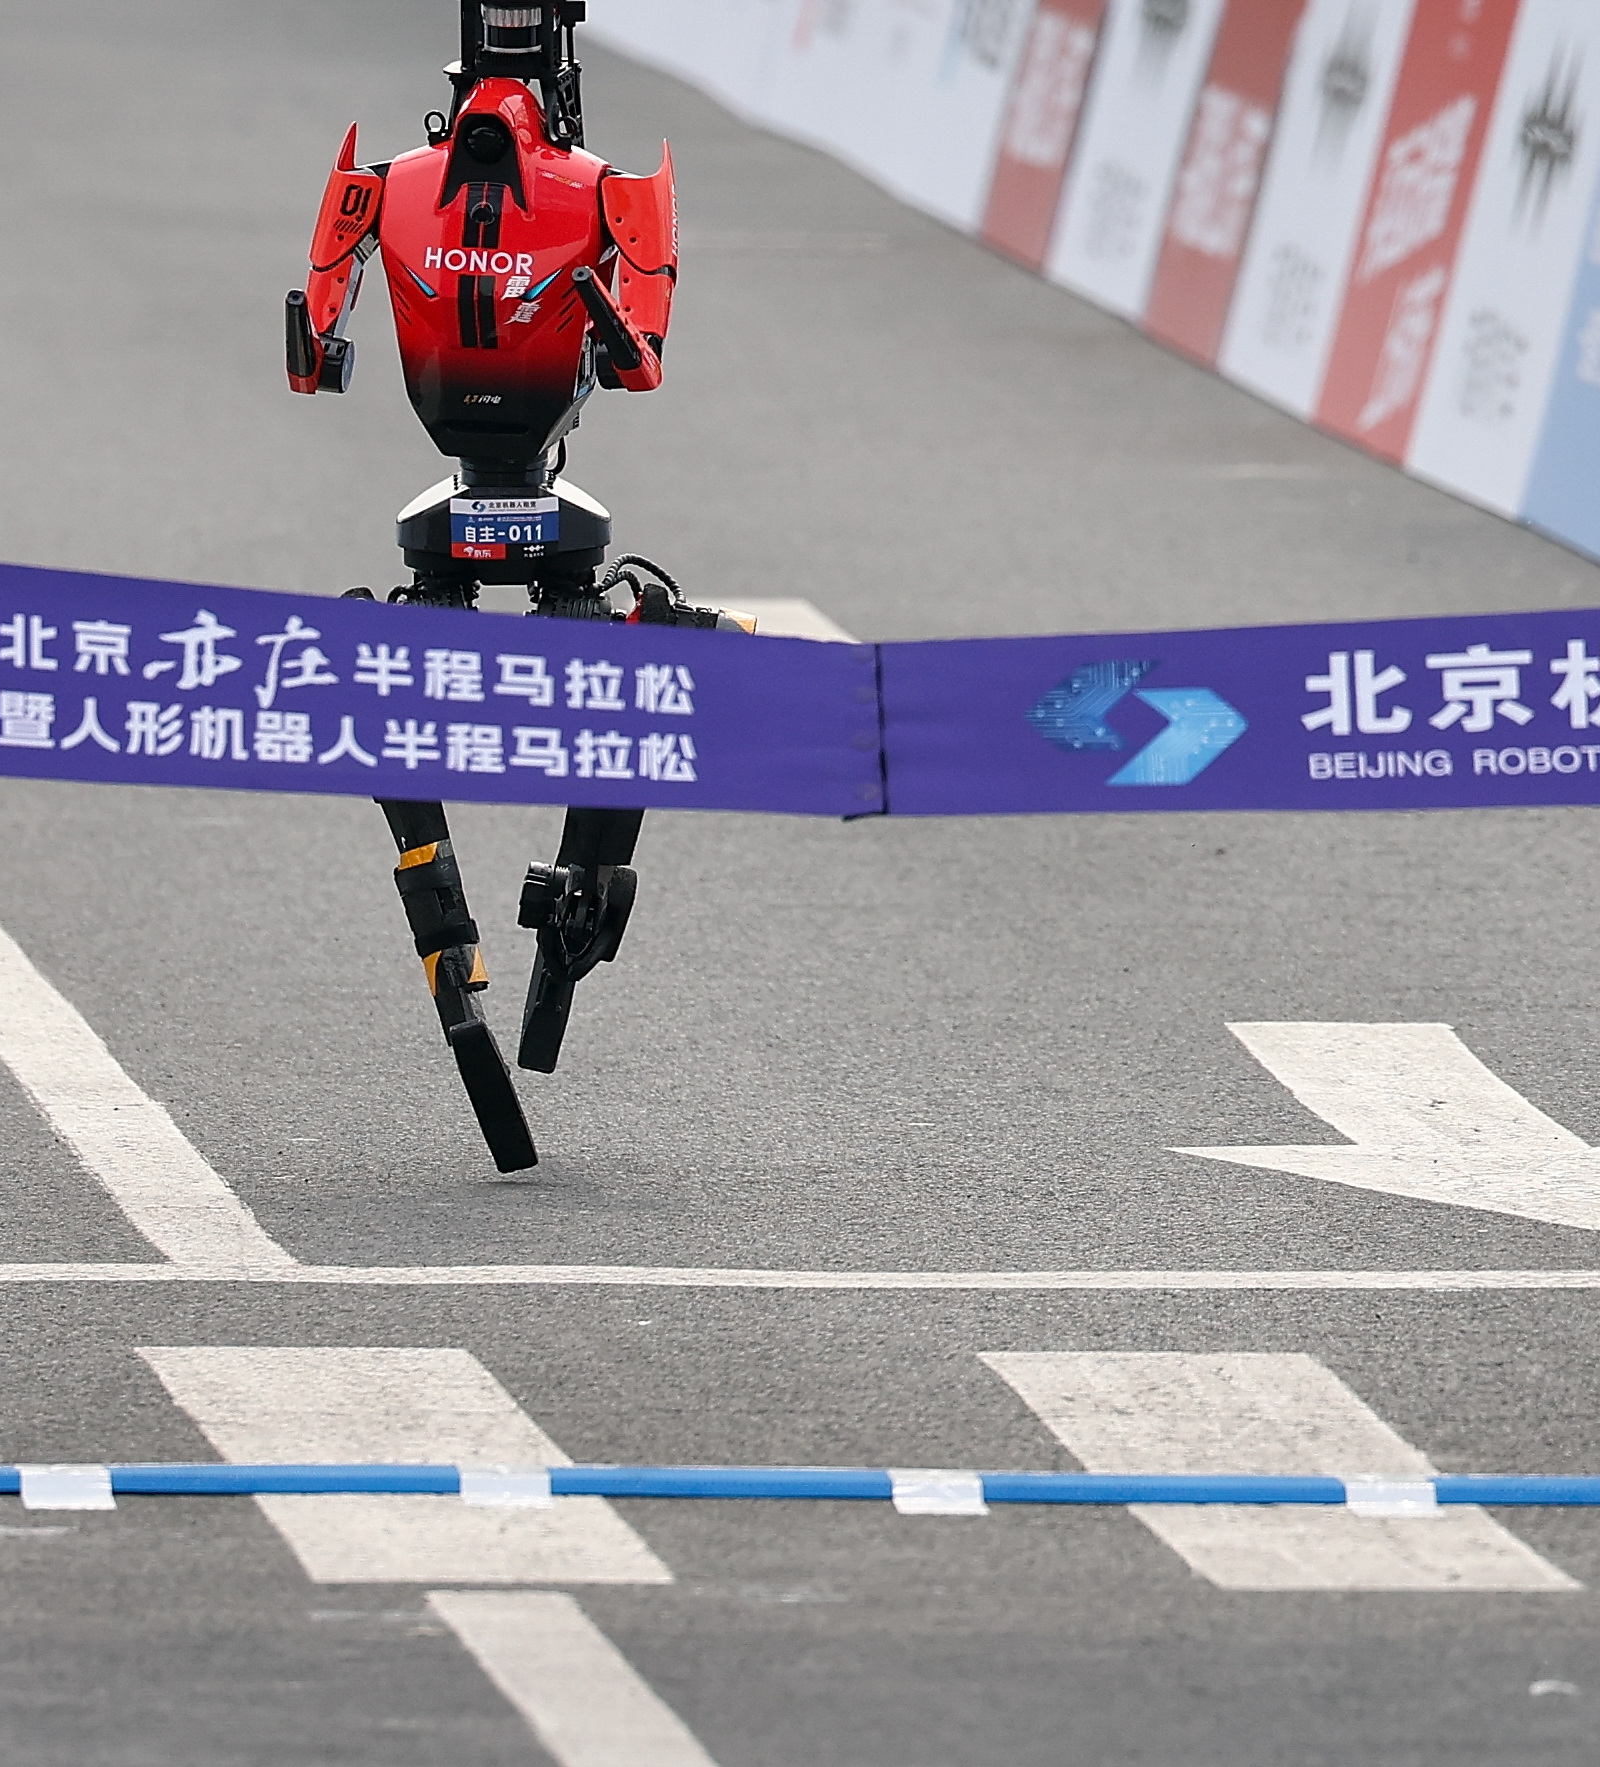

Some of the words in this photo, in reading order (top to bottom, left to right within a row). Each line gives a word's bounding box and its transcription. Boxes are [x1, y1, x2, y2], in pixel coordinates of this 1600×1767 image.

[340, 183, 373, 217] 01
[424, 246, 533, 275] HONOR
[465, 524, 542, 543] 自主-011
[1309, 750, 1452, 778] BEIJING
